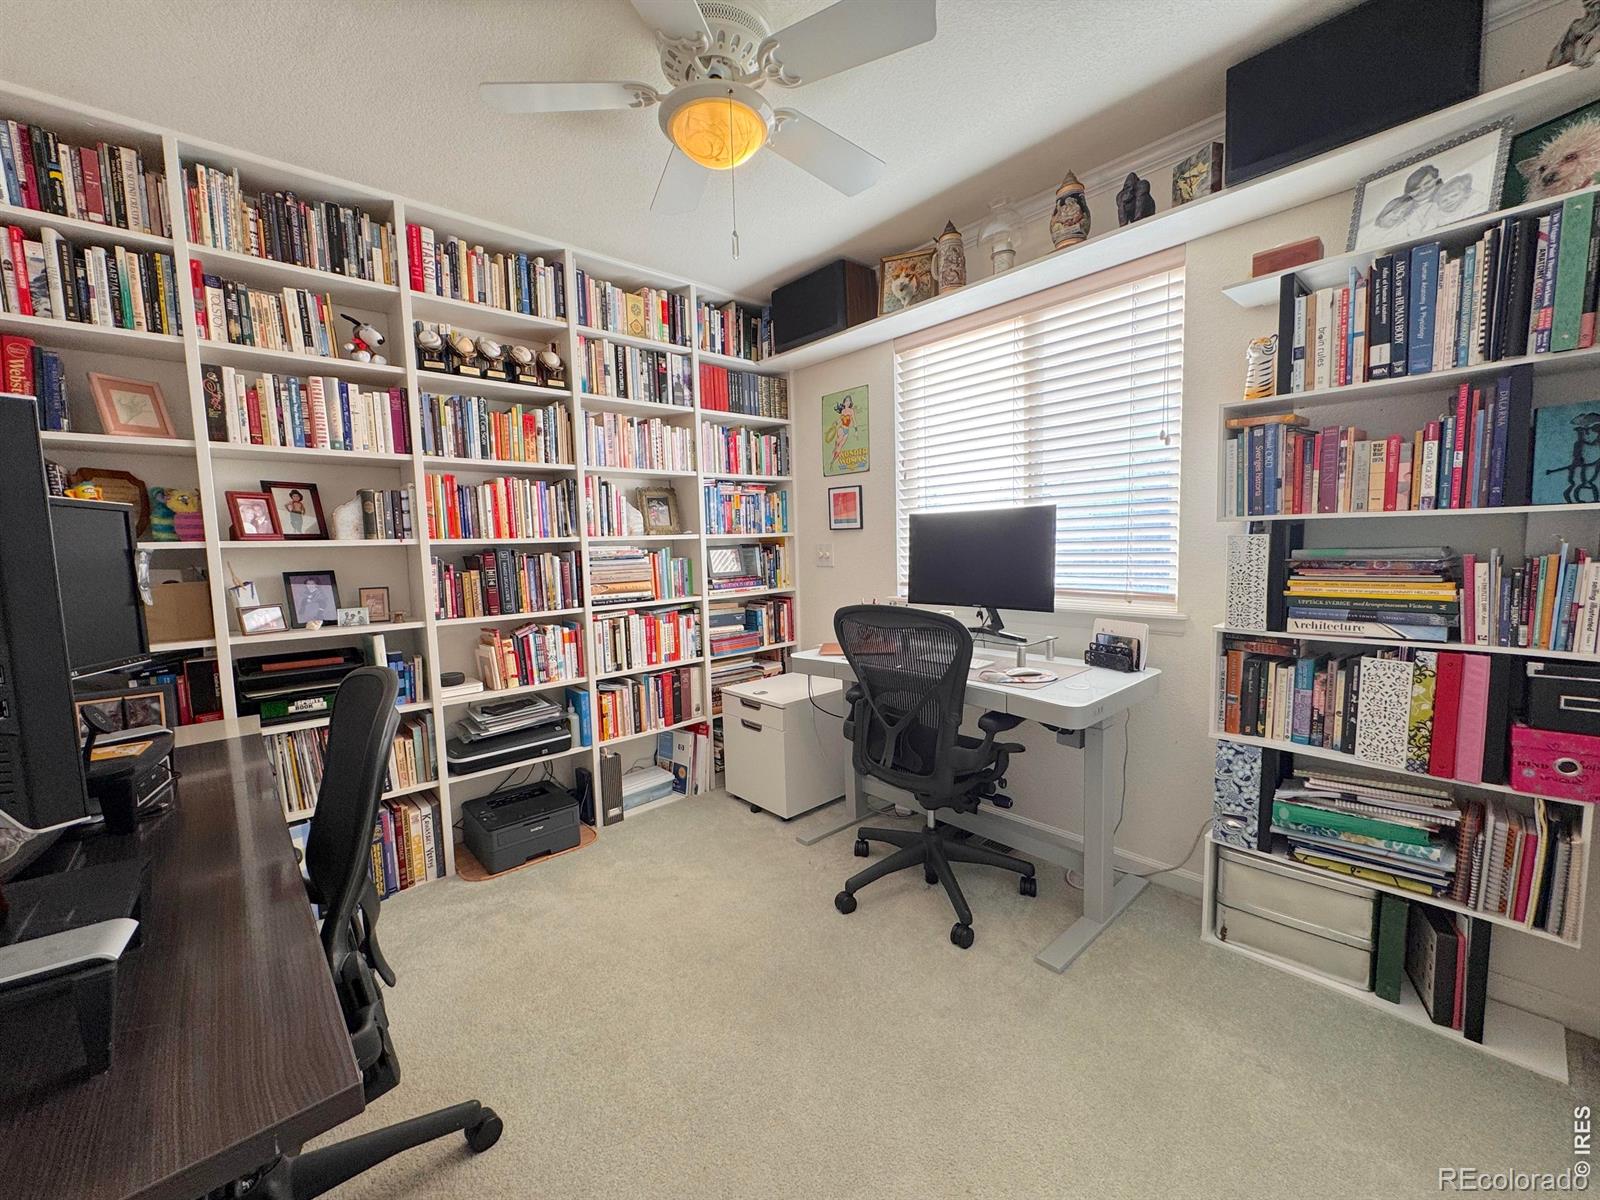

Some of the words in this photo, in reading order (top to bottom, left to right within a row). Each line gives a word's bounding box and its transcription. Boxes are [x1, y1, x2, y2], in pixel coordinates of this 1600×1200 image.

[422, 240, 434, 280] FIASCO
[1536, 248, 1546, 279] ANATOMY
[107, 261, 119, 297] MARTIAN
[210, 293, 225, 330] TOLSTOY
[1395, 296, 1404, 324] HUMAN
[1394, 324, 1404, 345] BODY
[1317, 347, 1325, 367] rules
[1496, 389, 1508, 427] DALARNA
[1253, 444, 1263, 471] Sveriges
[1425, 442, 1433, 459] Costa
[1293, 620, 1364, 633] Architecture
[1586, 601, 1597, 631] illustrated
[412, 834, 424, 877] CHILTON
